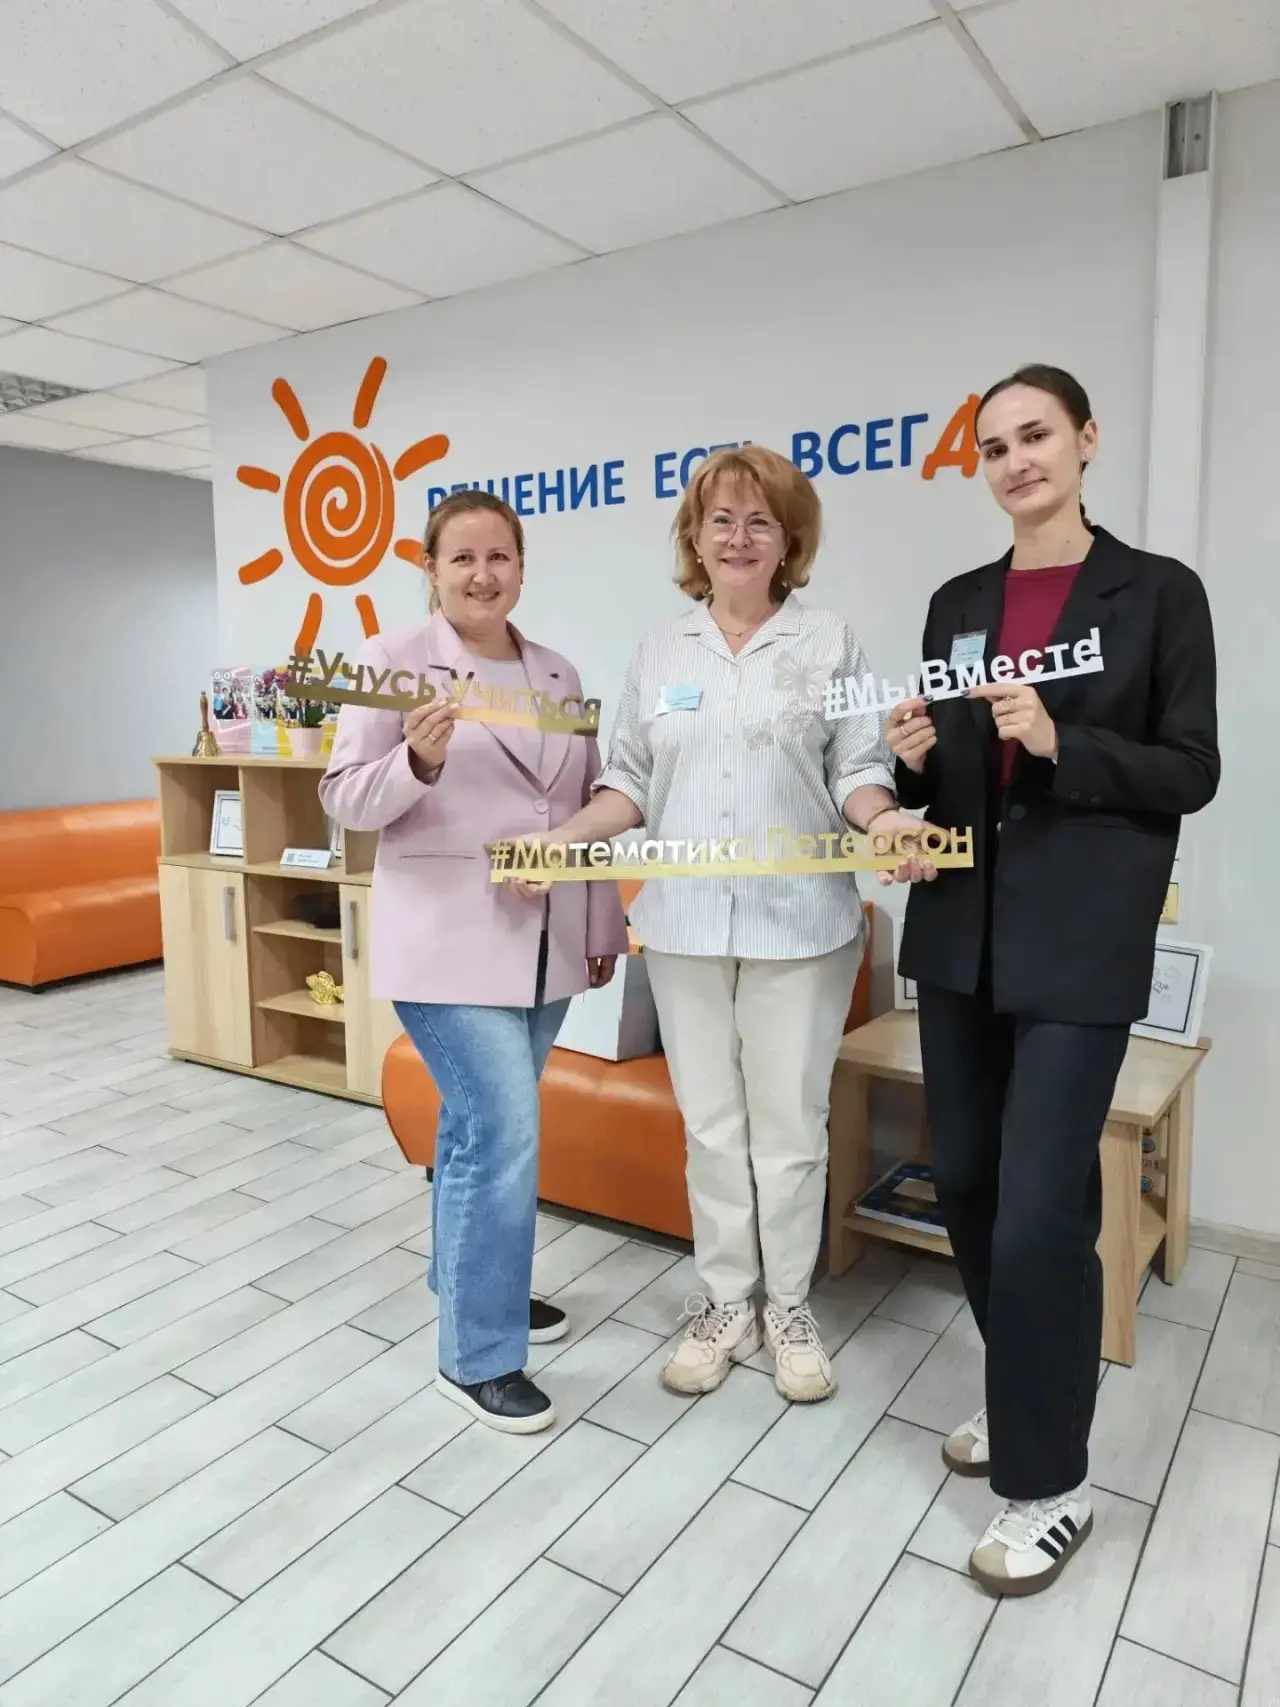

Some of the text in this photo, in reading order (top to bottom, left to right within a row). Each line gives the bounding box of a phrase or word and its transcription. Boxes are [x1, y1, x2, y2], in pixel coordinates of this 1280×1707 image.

[654, 440, 753, 499] ЕС
[286, 648, 437, 701] #Учусь
[767, 825, 974, 866] Петерсон
